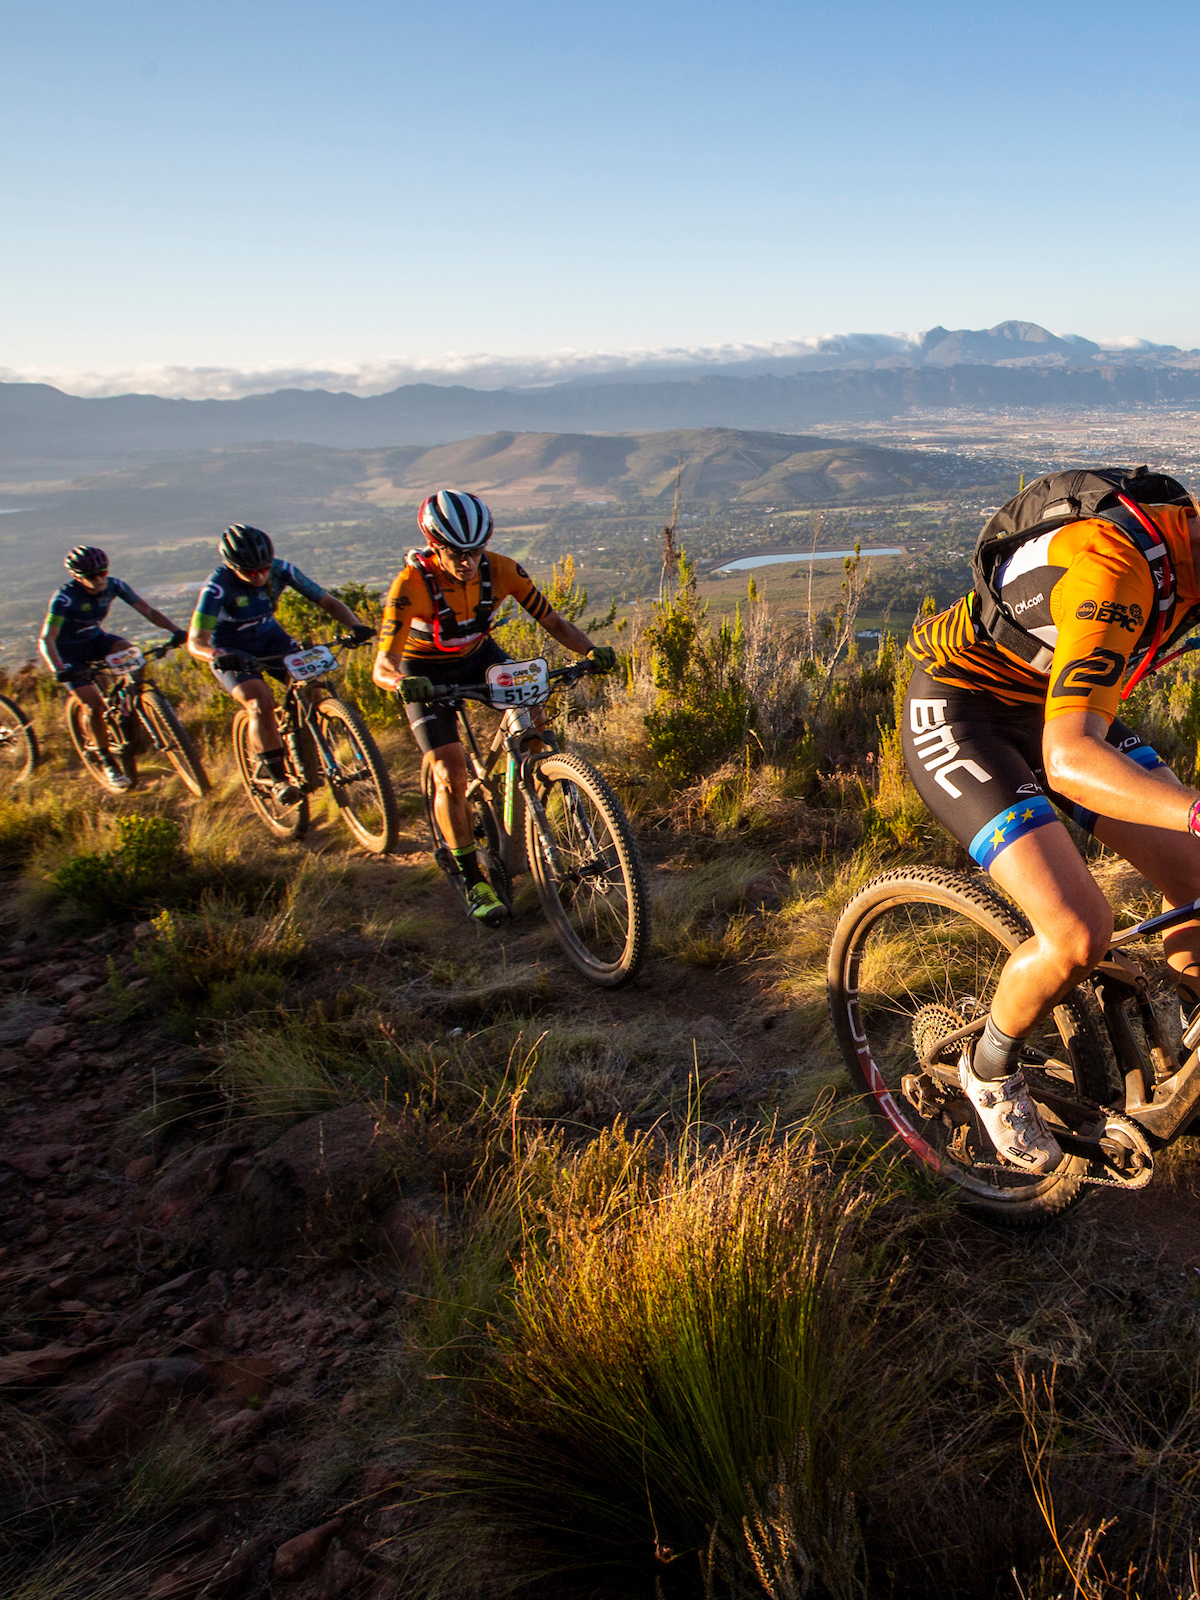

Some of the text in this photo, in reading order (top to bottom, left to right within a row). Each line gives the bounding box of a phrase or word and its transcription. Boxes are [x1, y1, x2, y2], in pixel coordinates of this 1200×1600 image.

[1014, 592, 1045, 616] CM.com
[1101, 600, 1129, 614] CAPE
[1095, 607, 1138, 633] EPIC
[298, 660, 329, 676] 59-2
[513, 673, 539, 687] EPIC
[504, 685, 540, 702] 51-2
[910, 698, 993, 800] BMC
